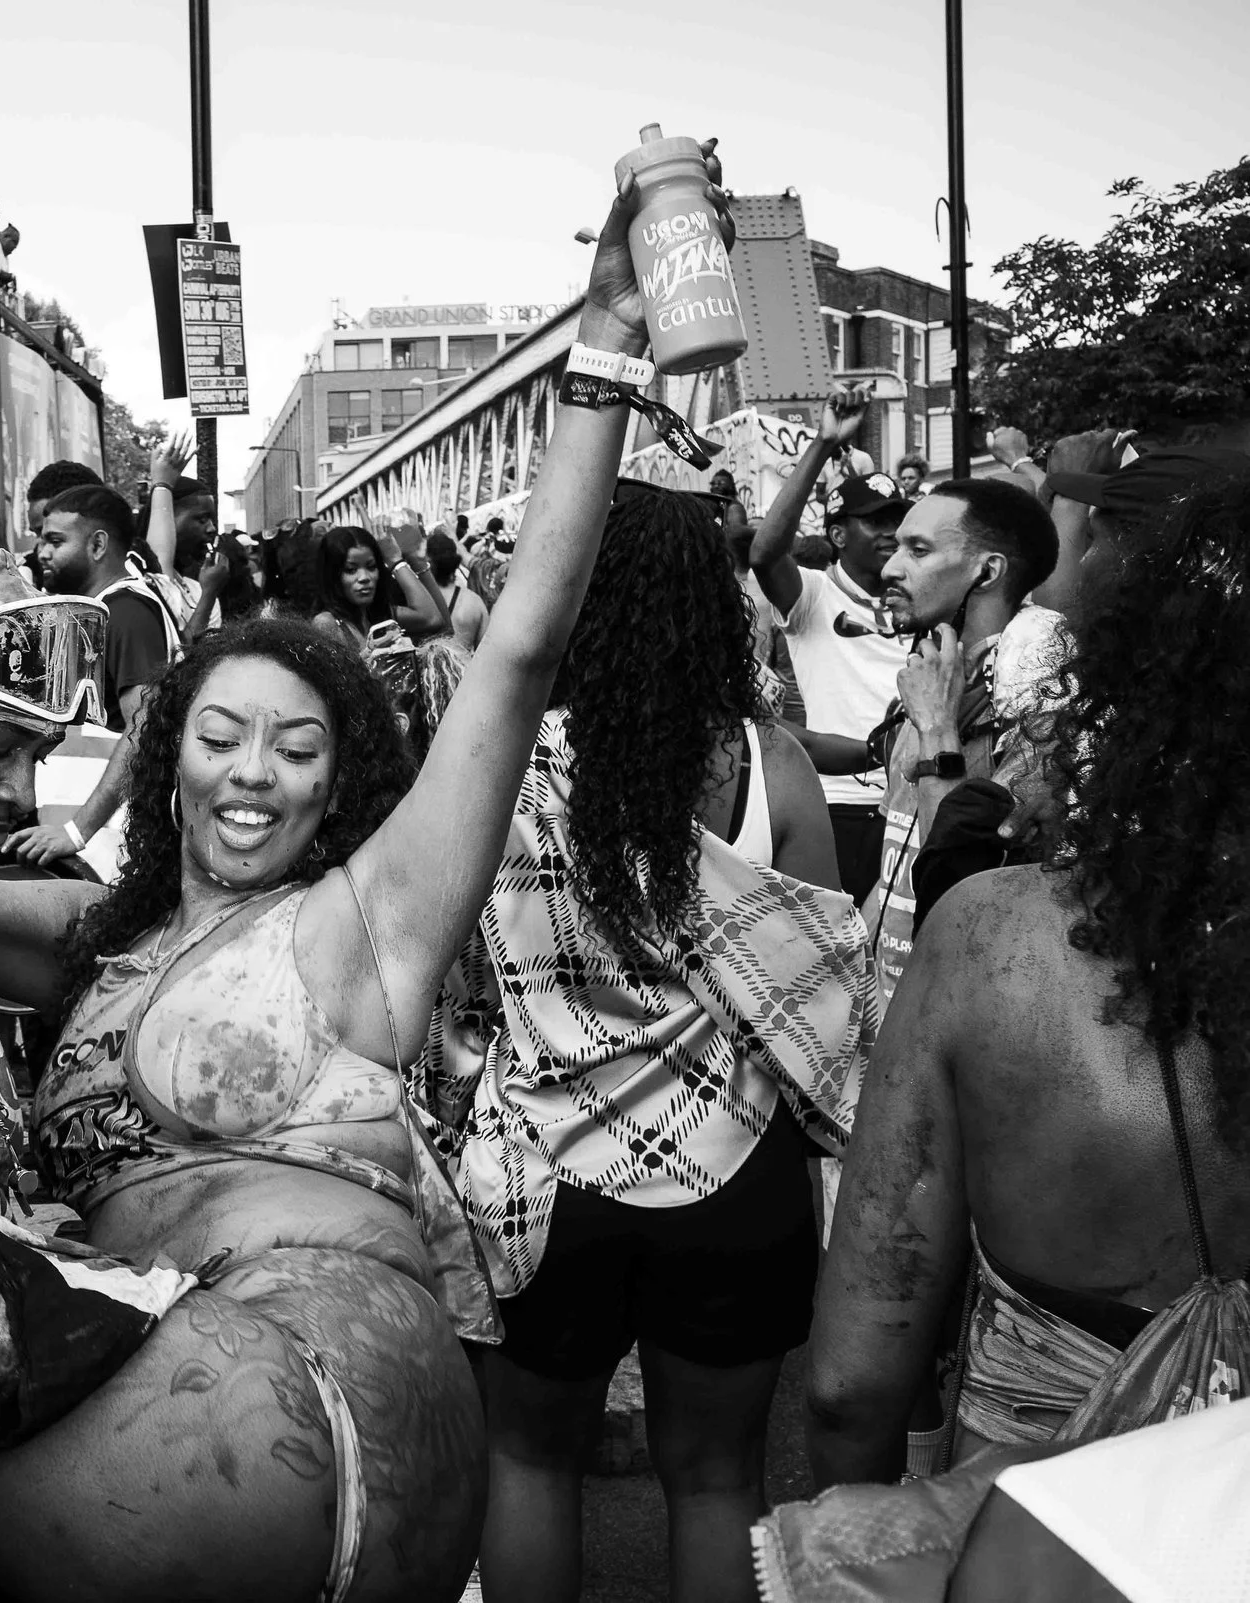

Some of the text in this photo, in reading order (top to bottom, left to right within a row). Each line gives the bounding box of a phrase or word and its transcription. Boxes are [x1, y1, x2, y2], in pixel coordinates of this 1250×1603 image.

[368, 308, 429, 326] GRAND
[434, 305, 493, 324] UNION
[658, 296, 735, 332] cantu
[889, 937, 914, 954] PLAY
